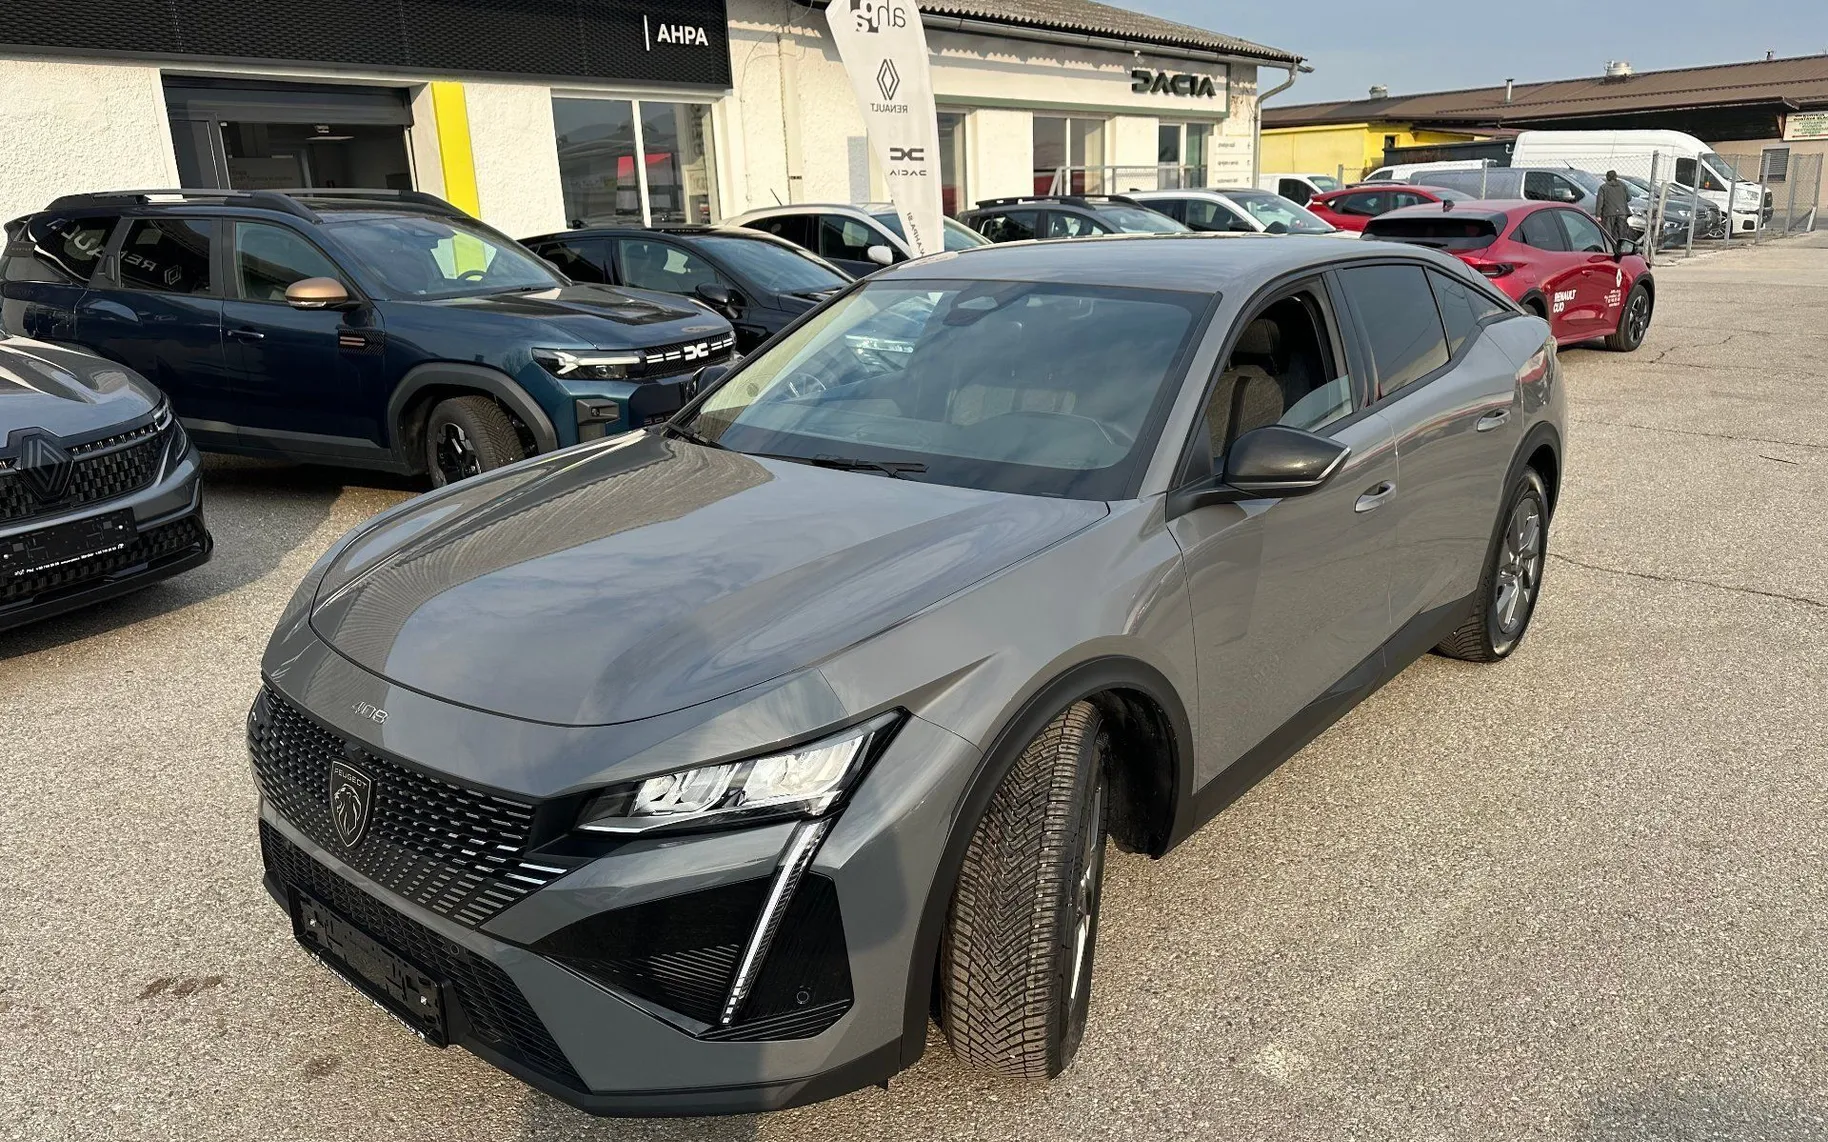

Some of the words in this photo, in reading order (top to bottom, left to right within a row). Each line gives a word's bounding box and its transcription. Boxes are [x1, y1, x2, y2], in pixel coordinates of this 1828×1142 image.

[657, 23, 709, 46] AHPA
[1131, 70, 1217, 97] DACIA
[1554, 289, 1577, 302] RENAULT
[351, 701, 389, 725] 408
[334, 767, 367, 789] PEUGEOT
